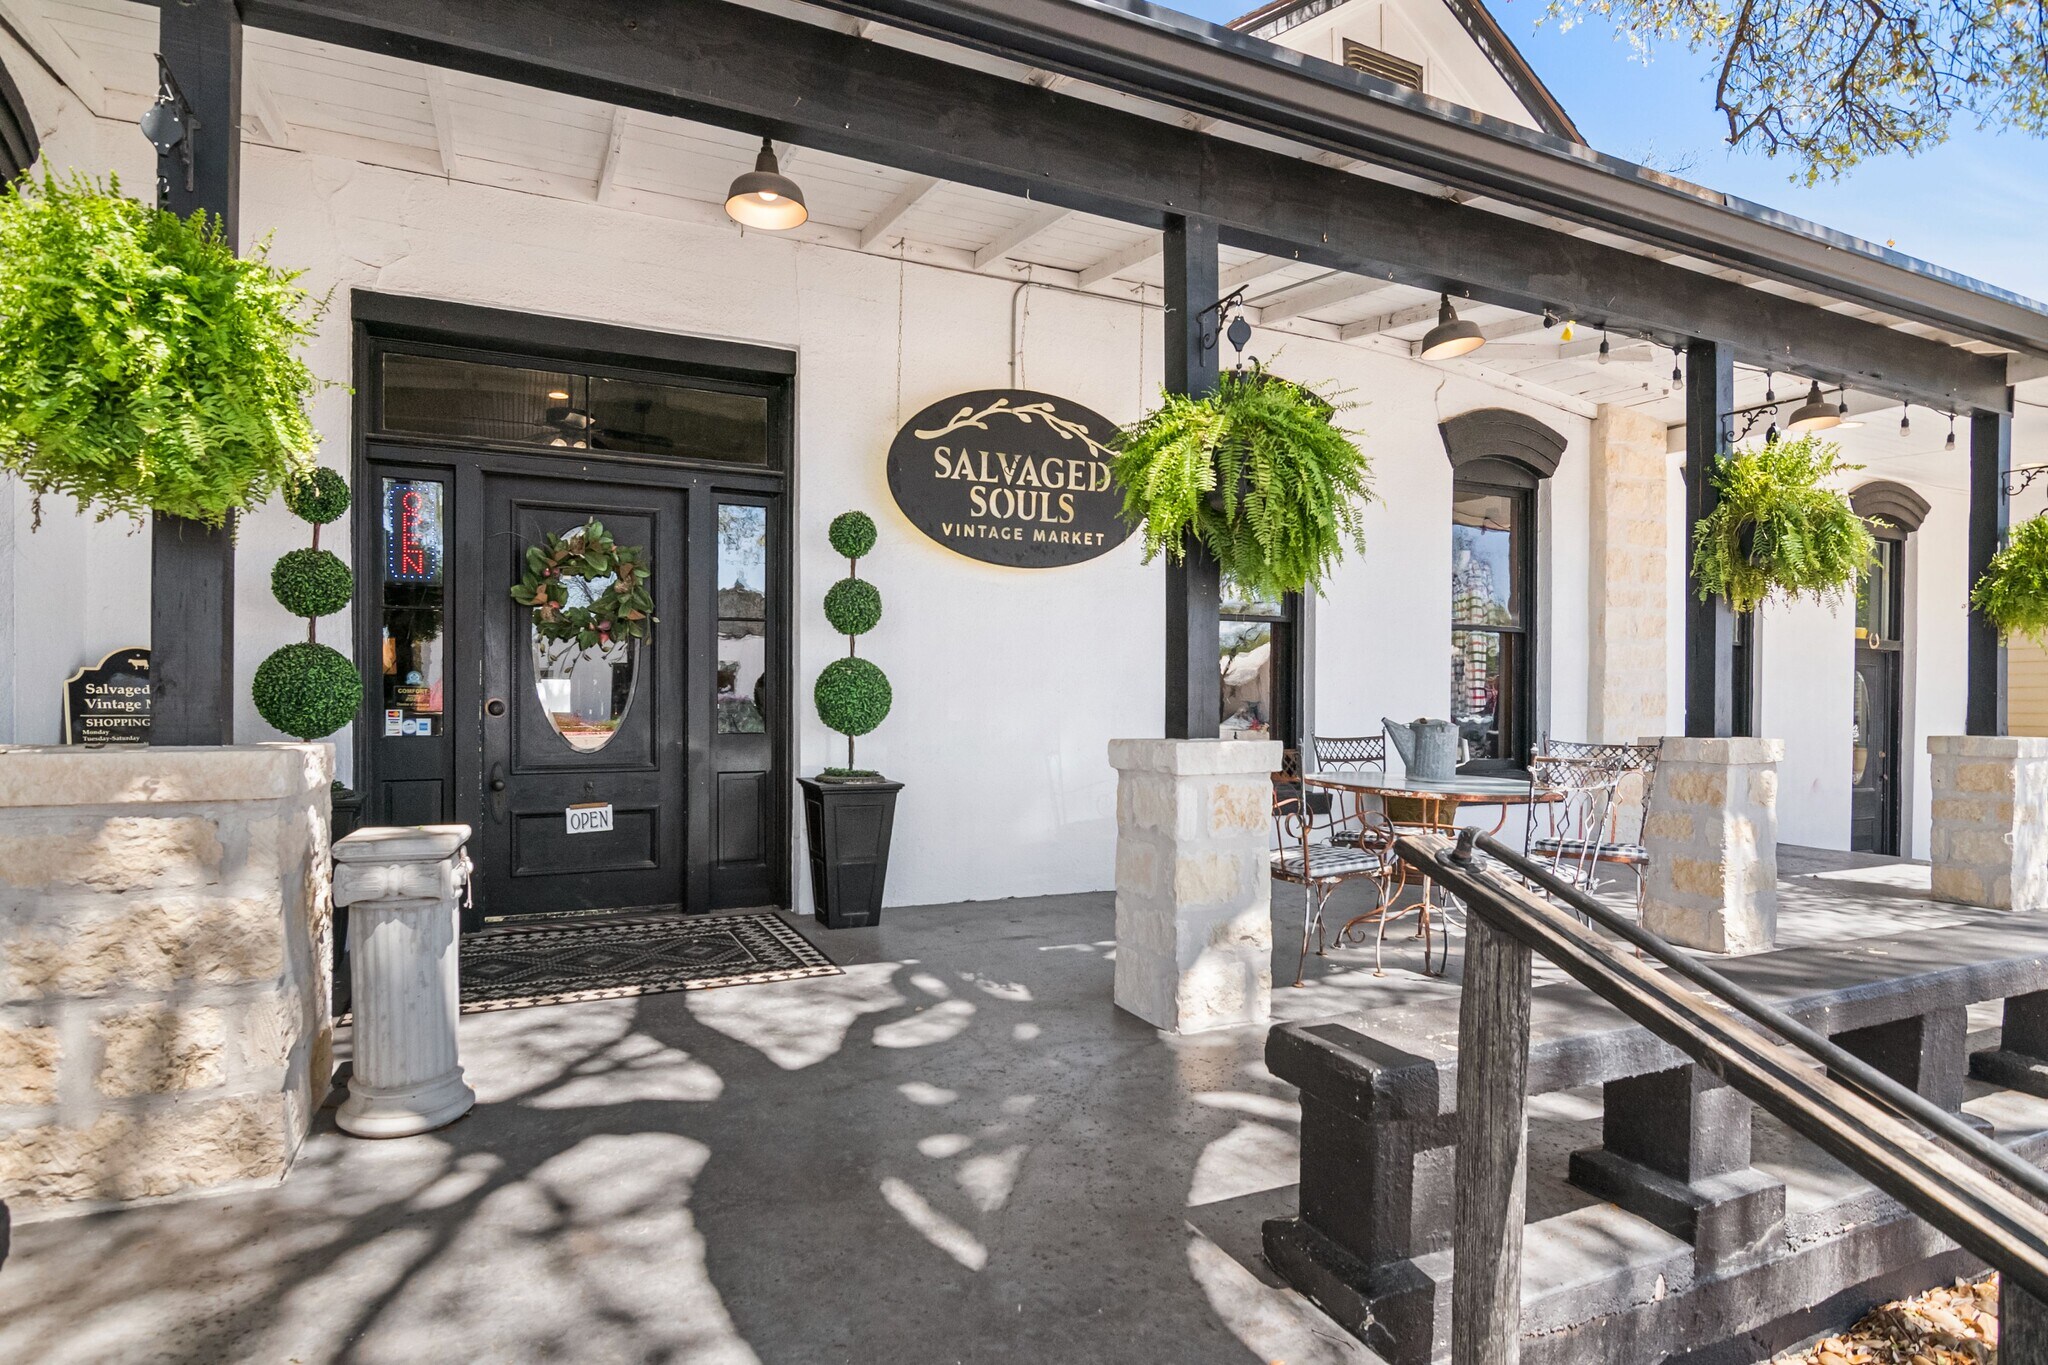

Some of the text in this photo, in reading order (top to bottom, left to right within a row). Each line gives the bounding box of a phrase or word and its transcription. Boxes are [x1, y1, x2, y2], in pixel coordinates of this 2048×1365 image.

[934, 446, 1111, 492] SALVAGED
[970, 486, 1075, 523] SOULS
[402, 491, 423, 574] OPEN
[942, 522, 1105, 546] VINTAGE MARKET
[85, 683, 151, 697] Salvaged
[84, 698, 142, 712] Vintage
[86, 718, 151, 727] SHOPPING
[571, 810, 609, 829] OPEN
